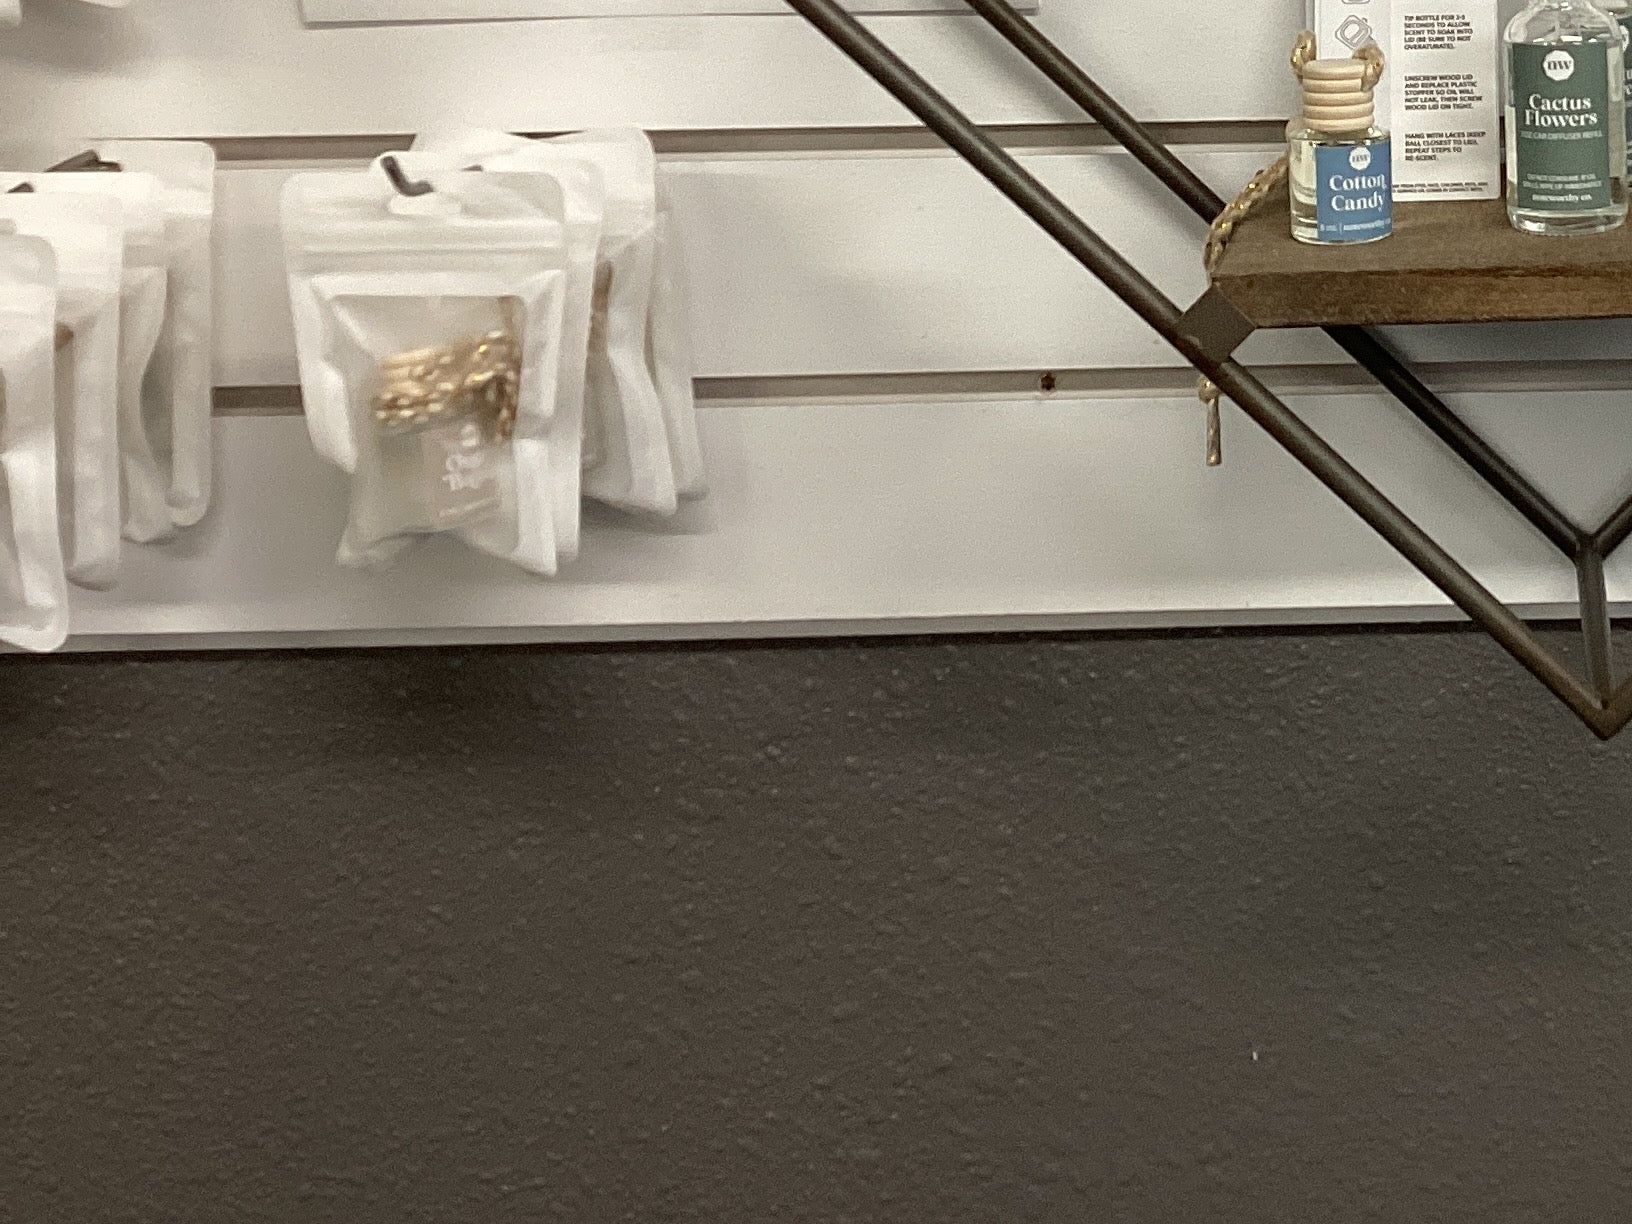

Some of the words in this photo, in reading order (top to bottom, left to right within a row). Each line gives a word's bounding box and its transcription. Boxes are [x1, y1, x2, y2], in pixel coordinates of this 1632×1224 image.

[1528, 93, 1592, 111] Cactus
[1525, 109, 1598, 127] Flowers
[1329, 174, 1388, 191] Cotton
[1331, 191, 1384, 212] Candy
